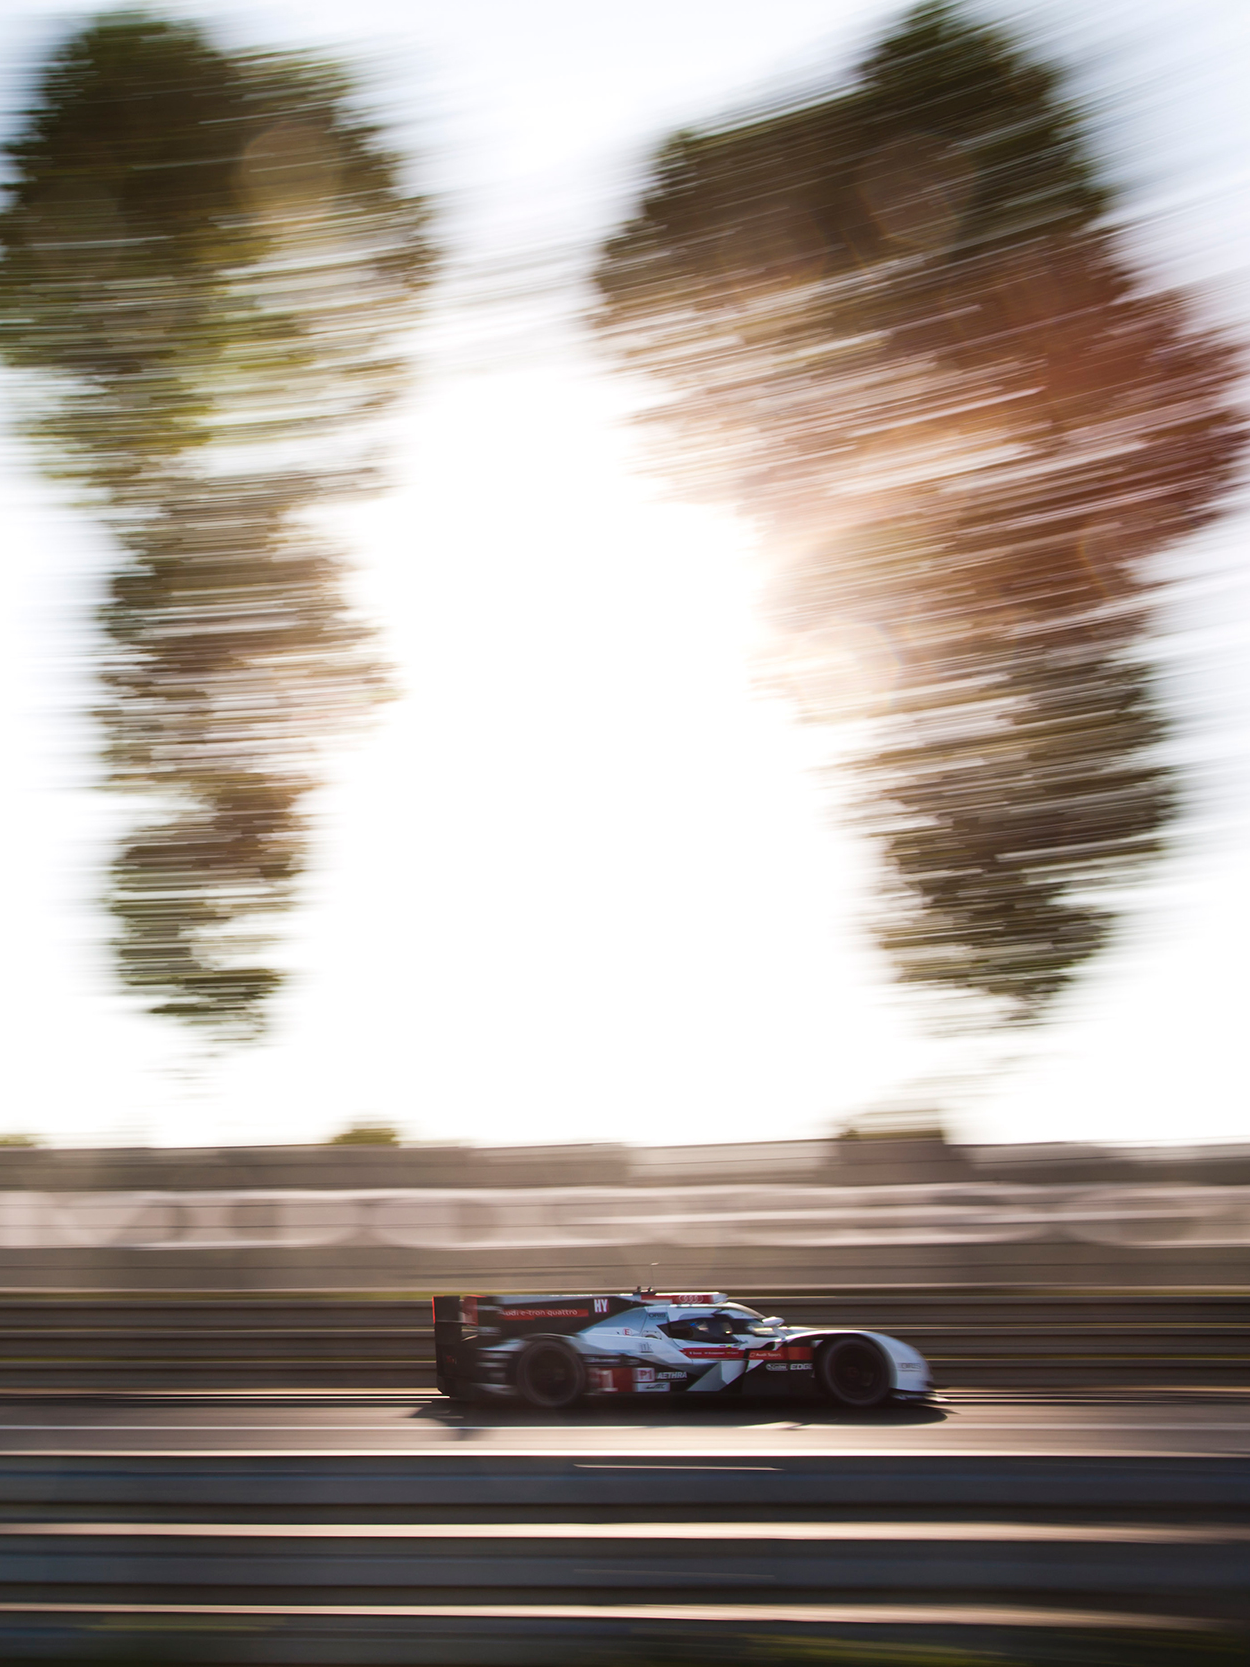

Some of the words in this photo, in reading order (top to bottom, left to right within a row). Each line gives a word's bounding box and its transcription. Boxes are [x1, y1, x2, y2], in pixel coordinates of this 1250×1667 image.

[594, 1298, 608, 1313] HY
[547, 1309, 578, 1317] quattro
[639, 1370, 653, 1380] P1
[657, 1371, 688, 1379] AETHRA
